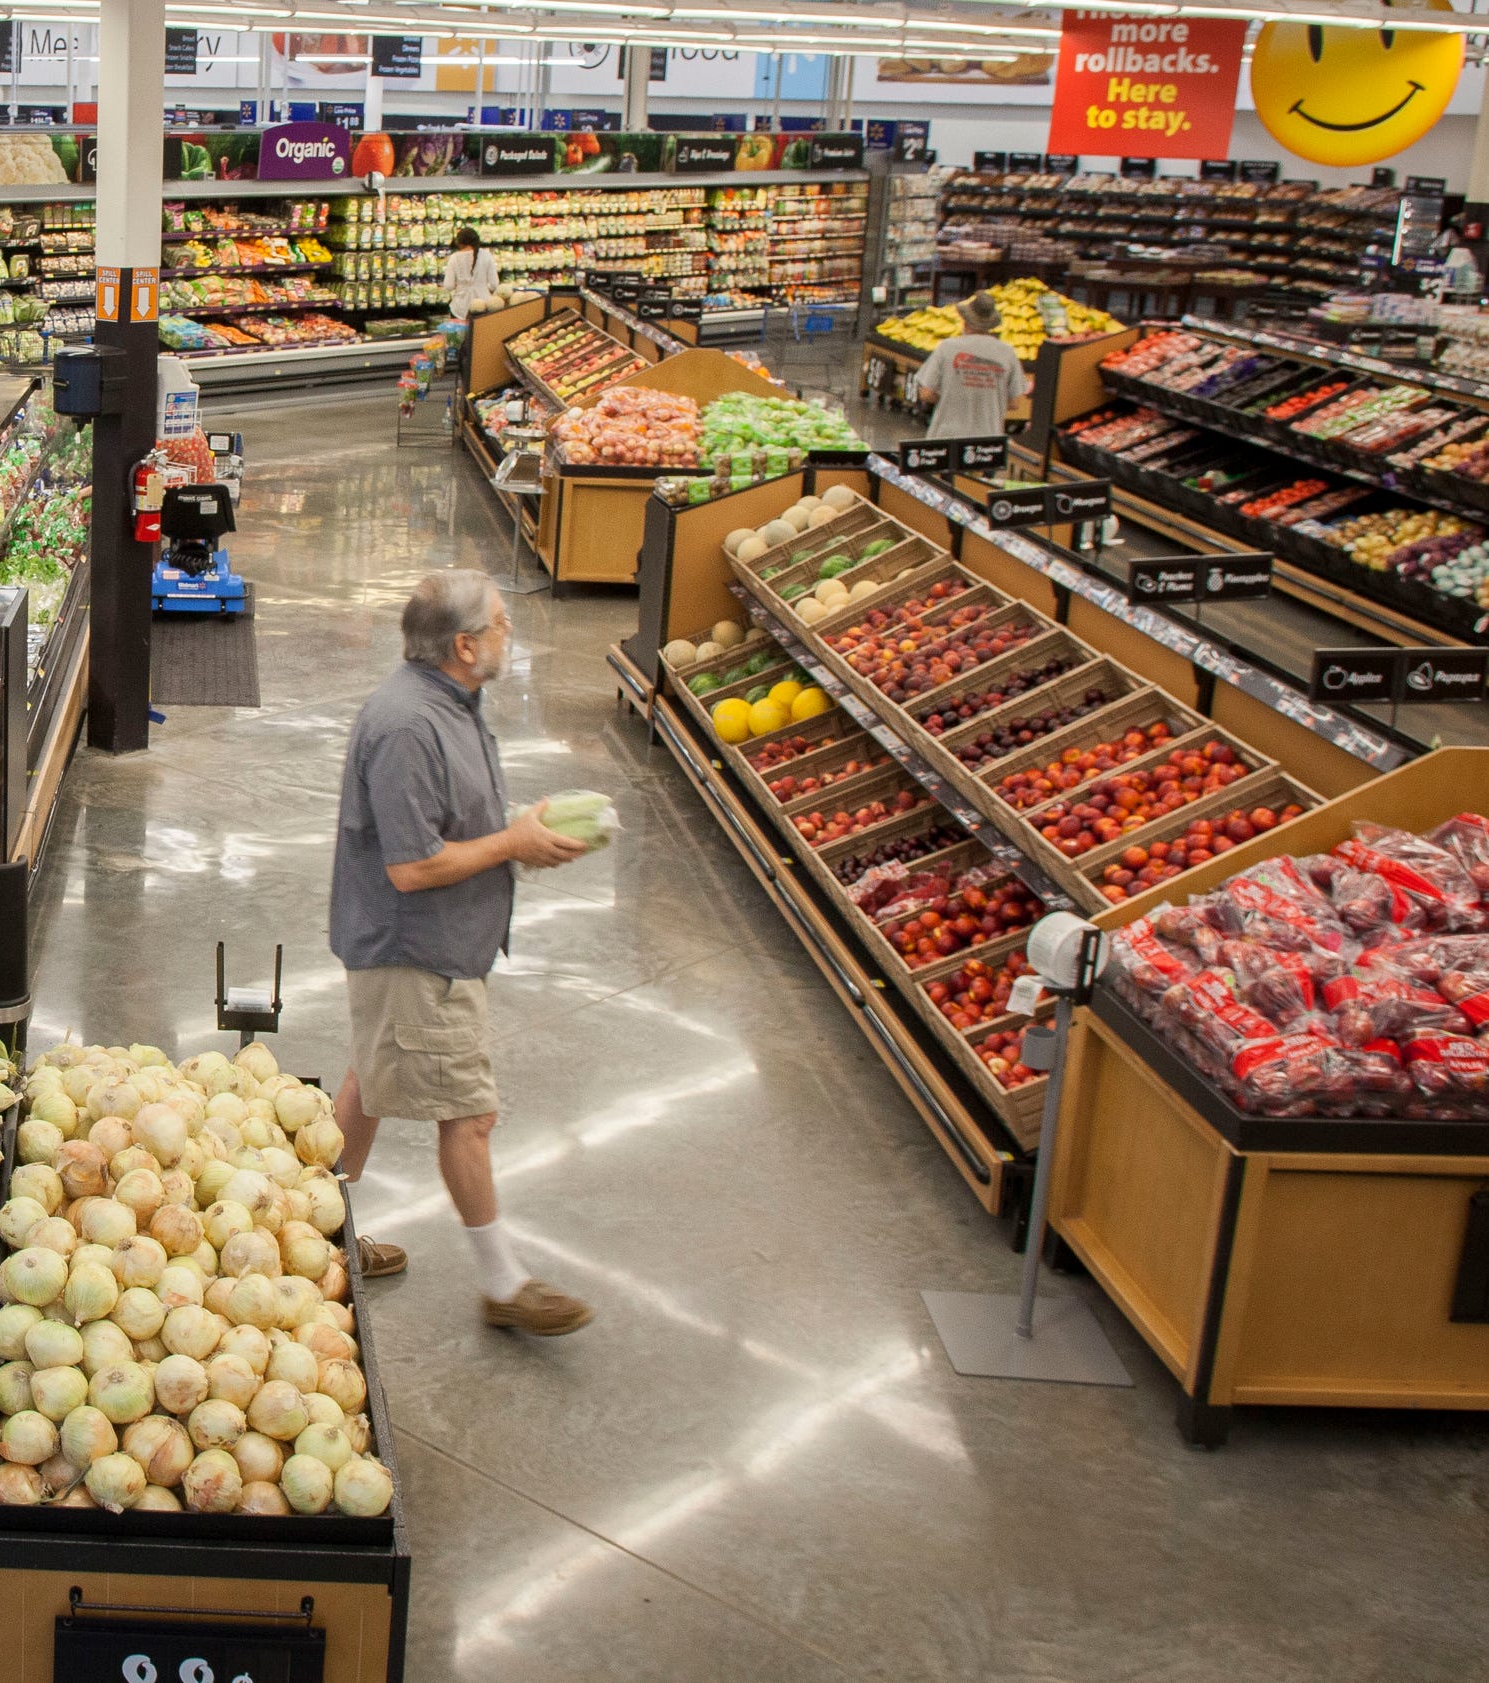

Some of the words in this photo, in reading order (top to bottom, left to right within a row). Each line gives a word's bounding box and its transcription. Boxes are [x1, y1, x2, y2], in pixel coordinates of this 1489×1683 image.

[1112, 23, 1190, 43] more
[1075, 47, 1219, 74] rollbacks.
[1107, 77, 1178, 103] Here
[1086, 105, 1117, 129] to
[1121, 106, 1191, 137] stay.
[275, 137, 336, 163] Organic
[102, 269, 116, 277] SPILL
[132, 277, 156, 285] CENTER
[135, 270, 153, 278] SPILL
[1158, 571, 1195, 581] Peaches
[1348, 672, 1383, 686] Apples
